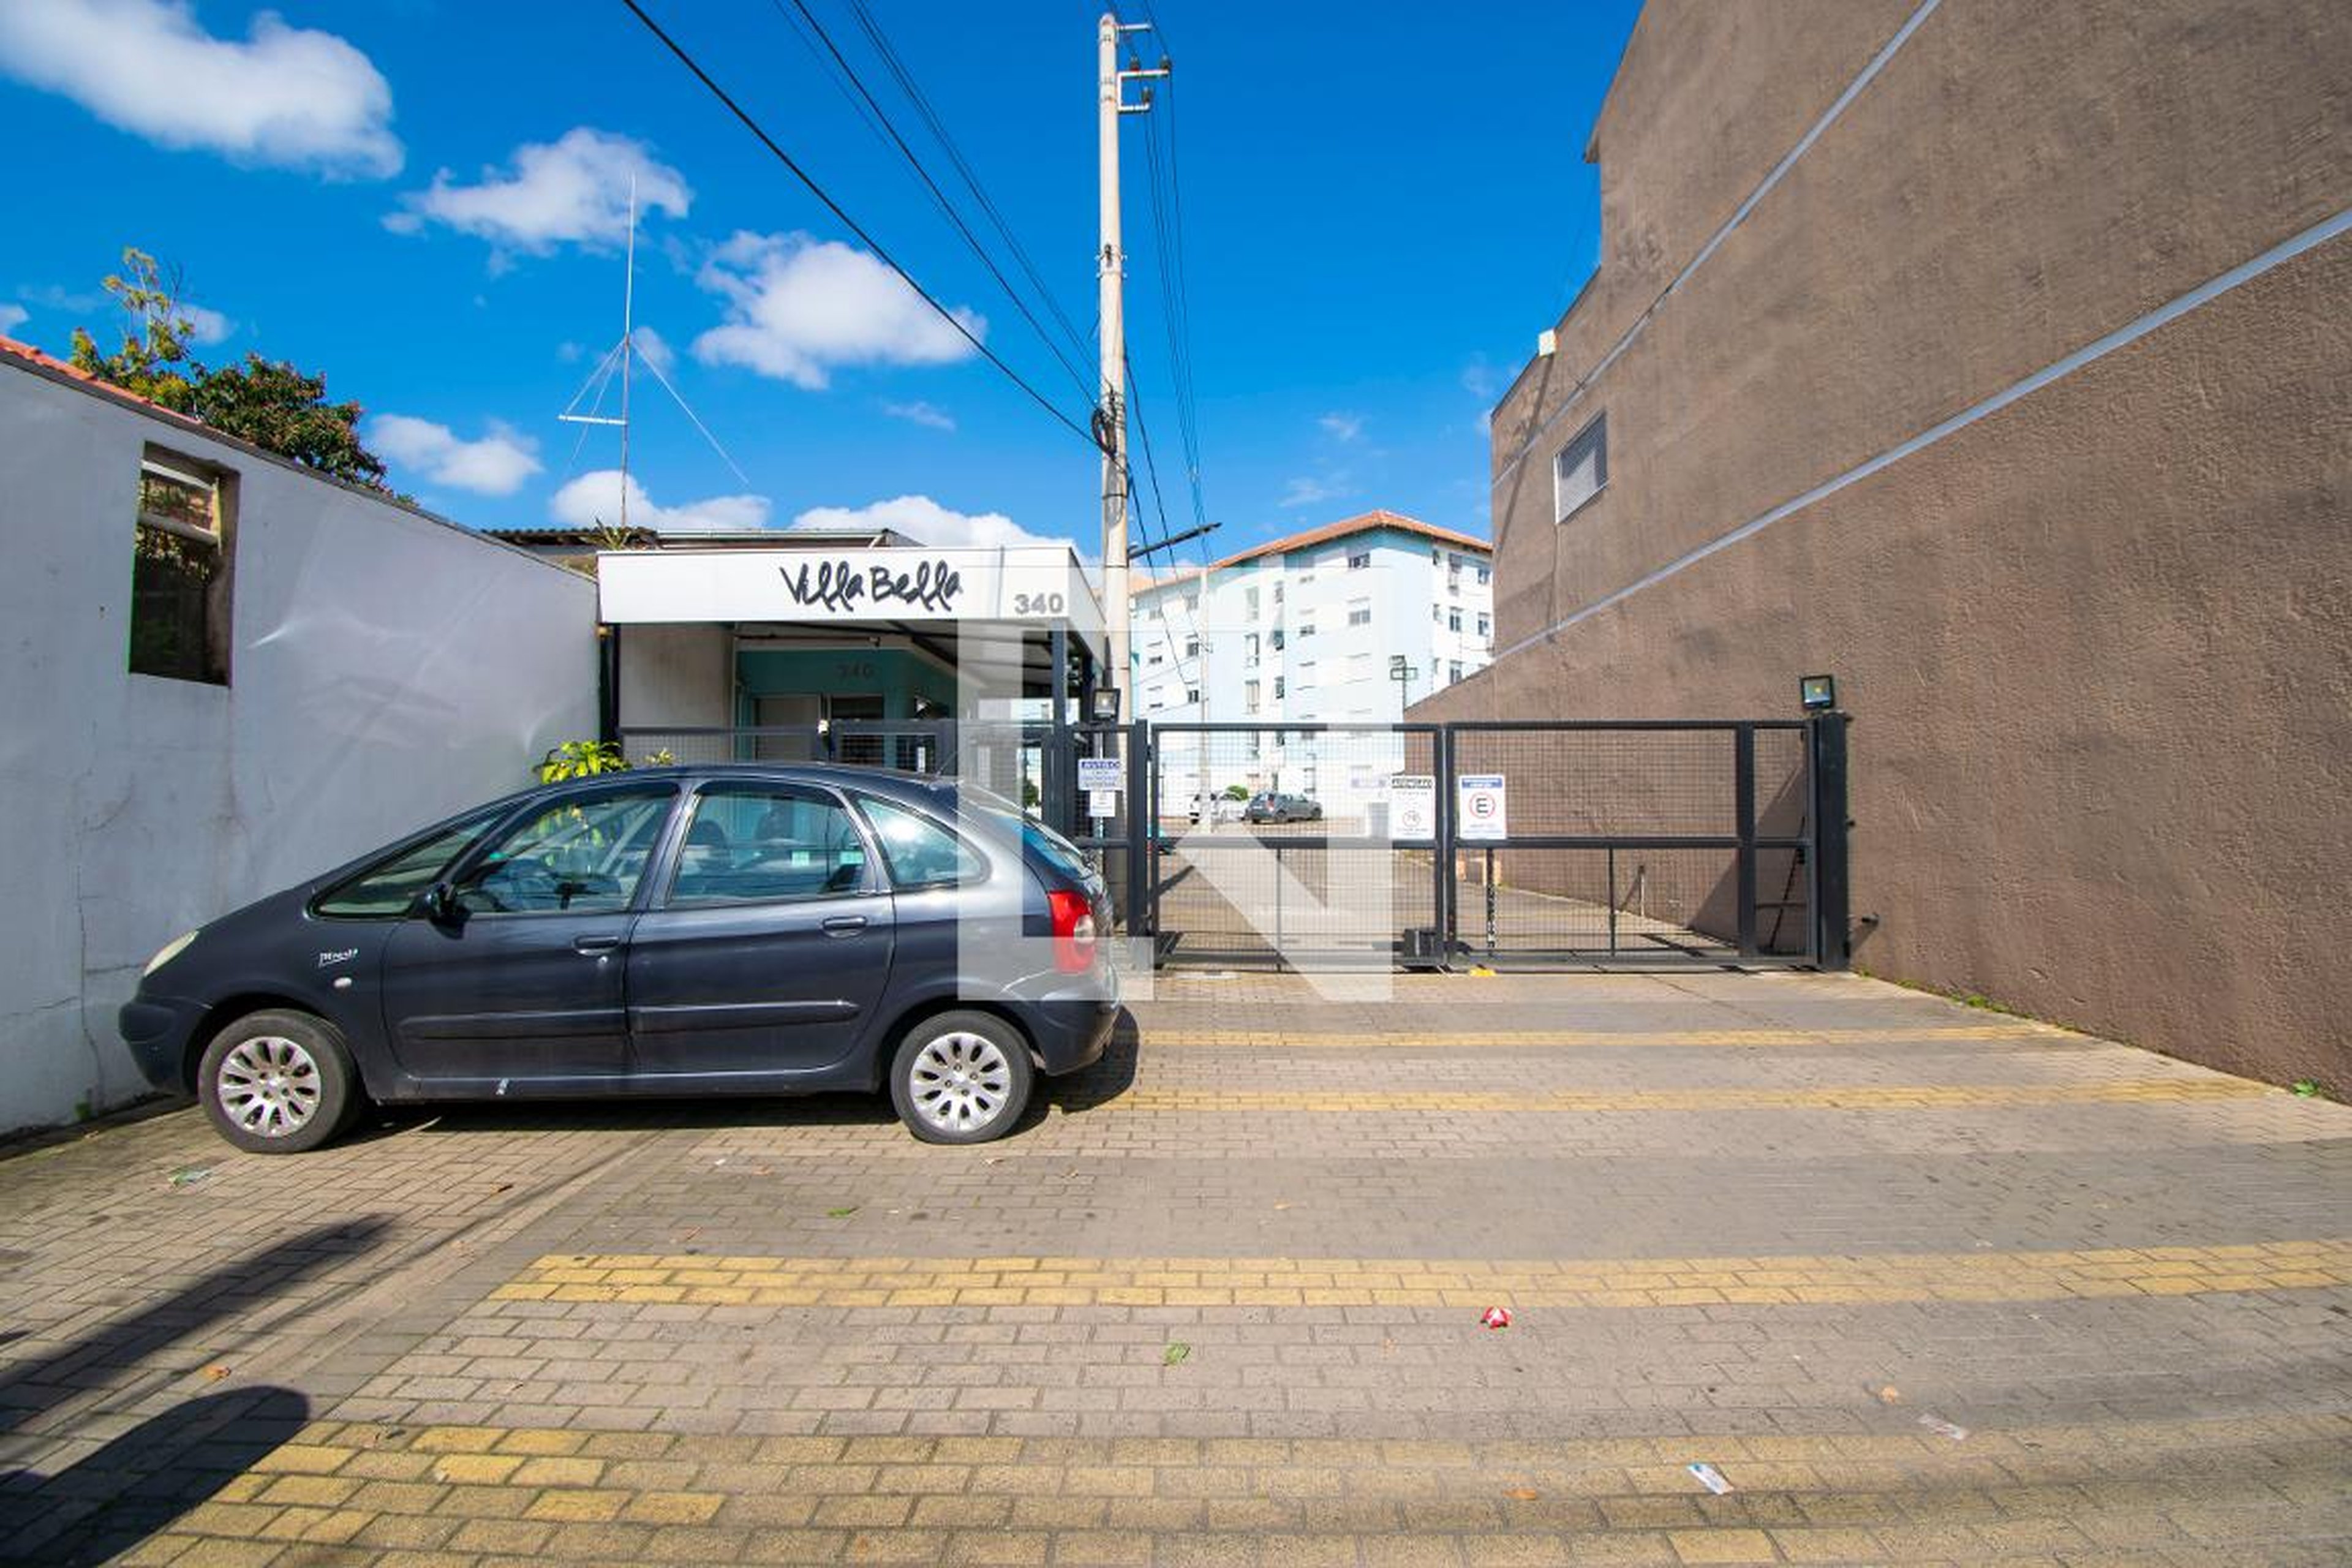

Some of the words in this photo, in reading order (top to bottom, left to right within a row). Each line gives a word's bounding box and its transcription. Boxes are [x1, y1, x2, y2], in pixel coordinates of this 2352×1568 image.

[779, 560, 864, 612] Villa
[870, 560, 963, 612] Bella
[1014, 592, 1064, 614] 340
[1476, 797, 1488, 813] E
